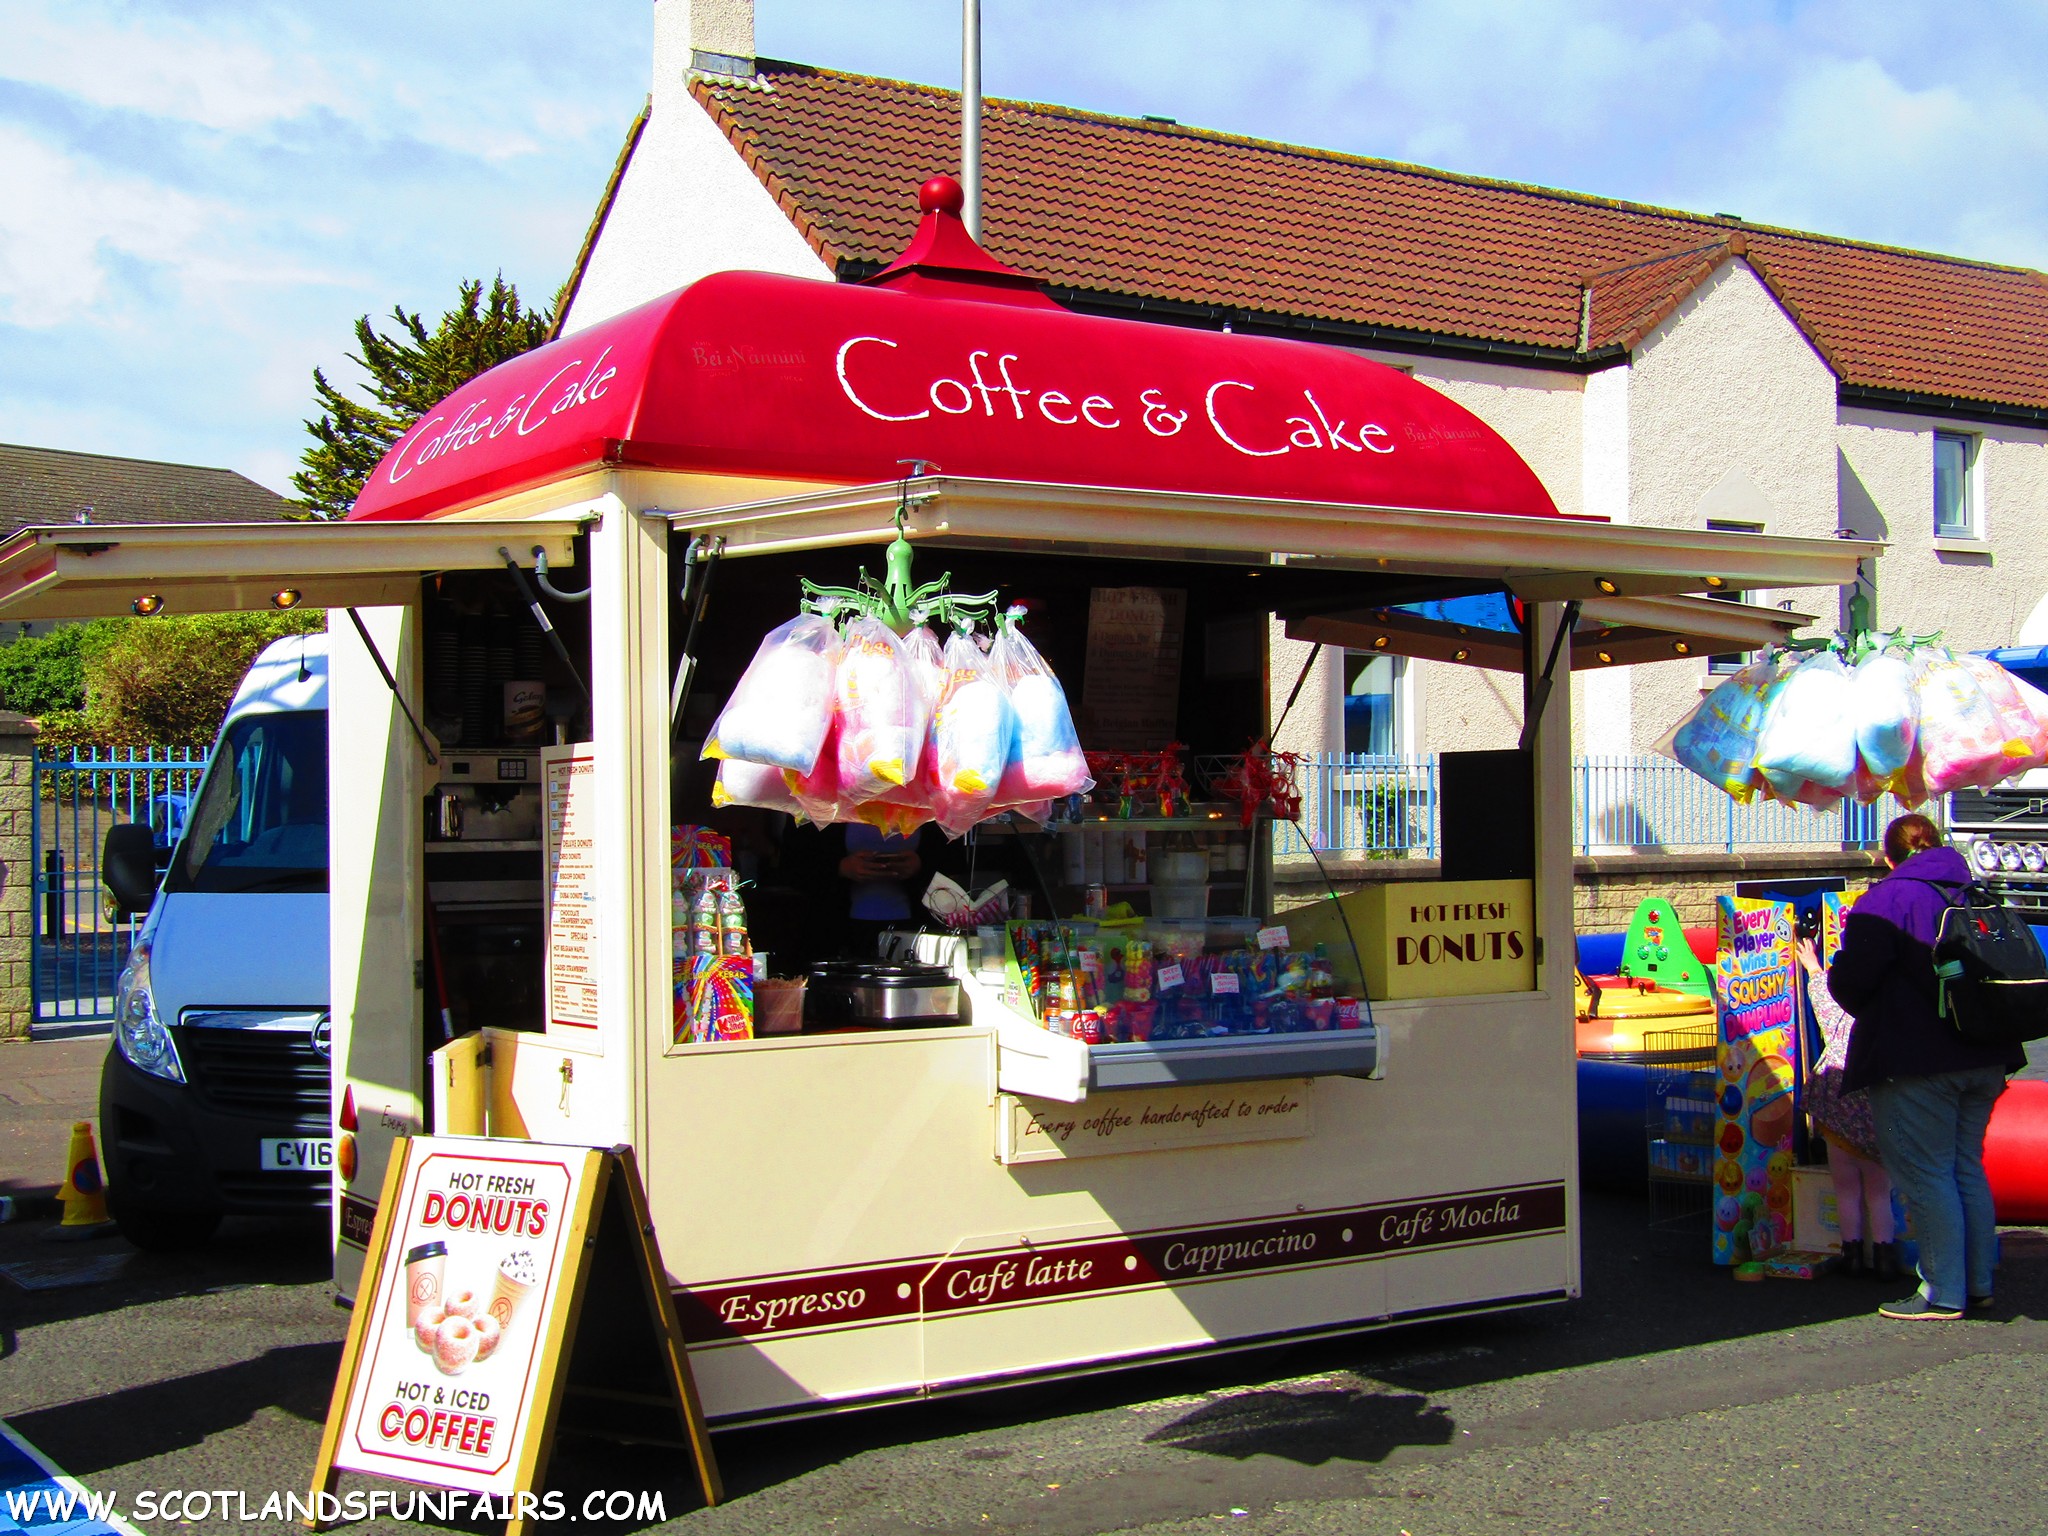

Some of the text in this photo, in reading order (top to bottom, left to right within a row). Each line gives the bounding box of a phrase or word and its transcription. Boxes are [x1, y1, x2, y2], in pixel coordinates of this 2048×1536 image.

[388, 344, 617, 485] Coffee & Cake
[836, 336, 1395, 457] Coffee & Cake
[1410, 902, 1511, 923] HOT FRESH
[1732, 907, 1771, 935] Every
[1396, 930, 1524, 966] DONUTS
[1733, 931, 1776, 958] Player
[1769, 952, 1778, 967] a
[1728, 969, 1787, 1010] SQUSHY
[1724, 996, 1792, 1040] DUMPLING
[1025, 1095, 1299, 1141] Every coffee handcrafted to order
[449, 1172, 535, 1196] HOT FRESH
[420, 1191, 550, 1238] DONUTS
[1163, 1197, 1521, 1274] Cappuccino Café Mocha
[719, 1255, 1093, 1330] Espresso Café latte
[395, 1380, 490, 1411] HOT & ICED
[378, 1400, 498, 1457] COFFEE
